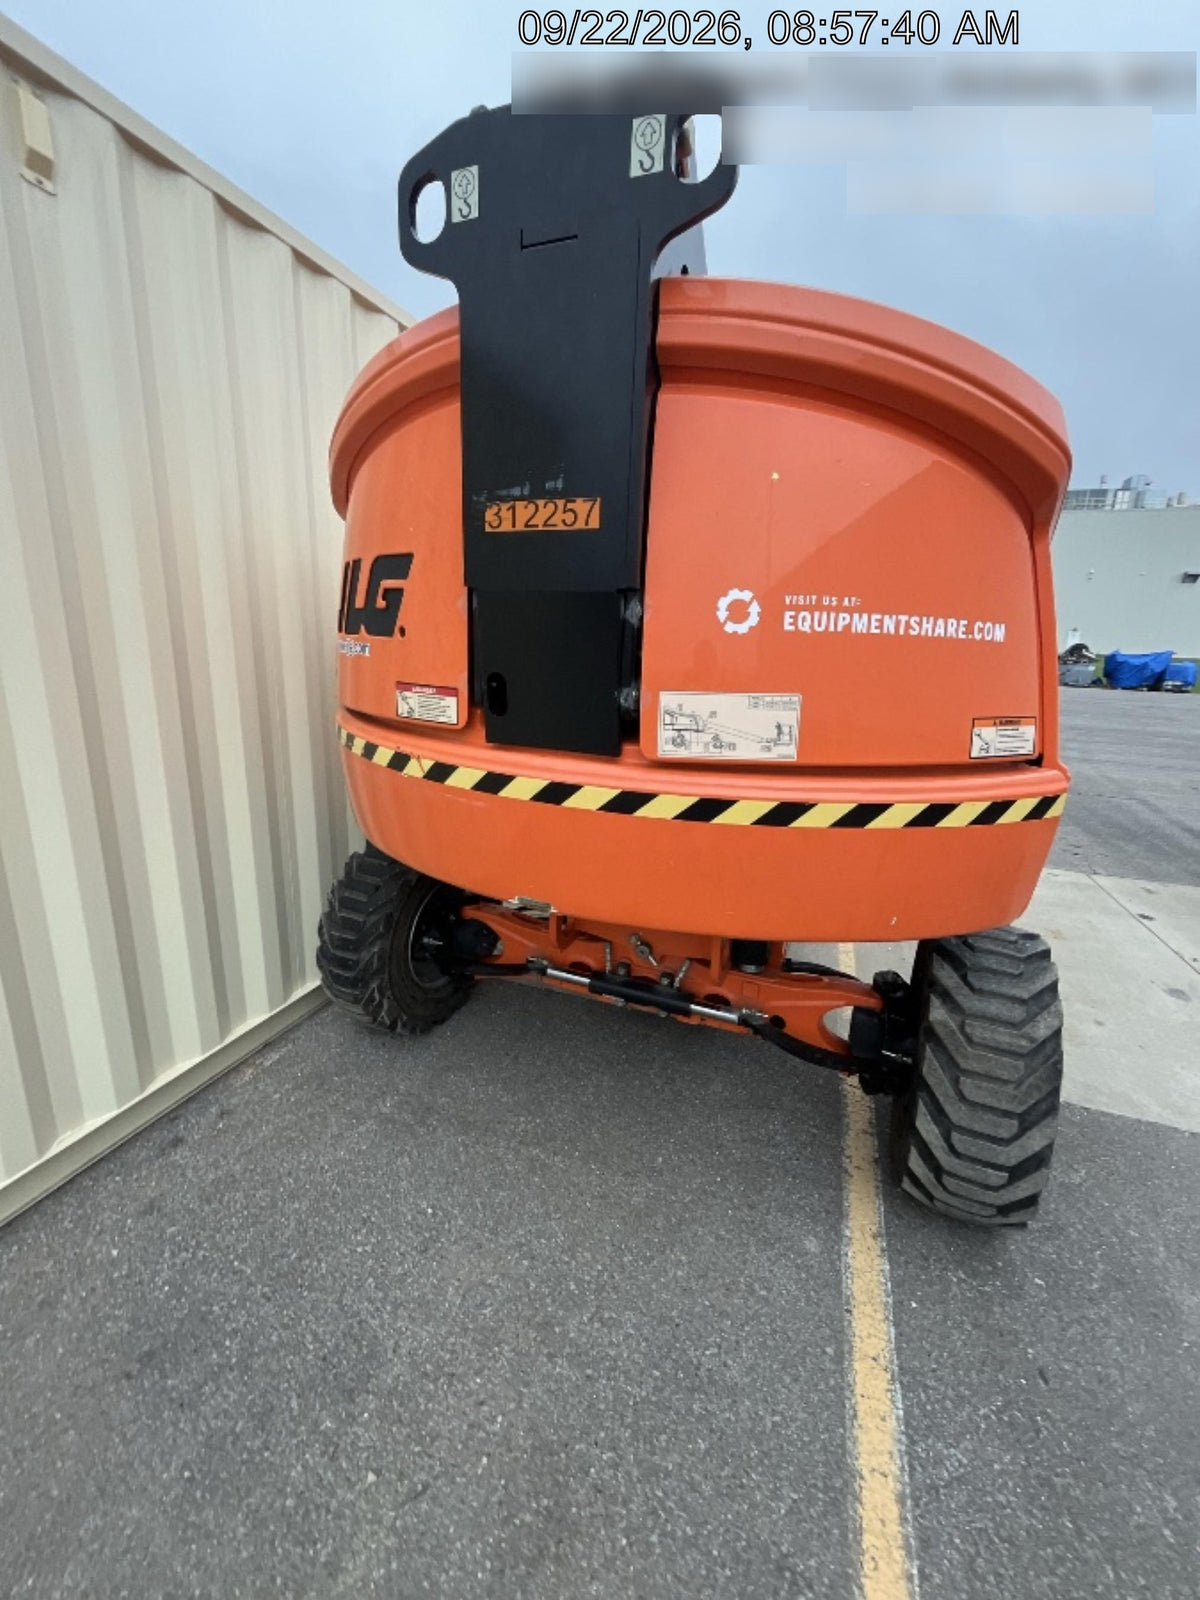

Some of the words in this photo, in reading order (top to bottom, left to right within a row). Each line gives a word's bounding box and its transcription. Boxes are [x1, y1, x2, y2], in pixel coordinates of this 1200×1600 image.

[487, 499, 598, 529] 312257
[785, 595, 817, 606] VISIT
[822, 595, 838, 607] US
[783, 611, 1006, 643] EQUIPMENTSHARE.COM
